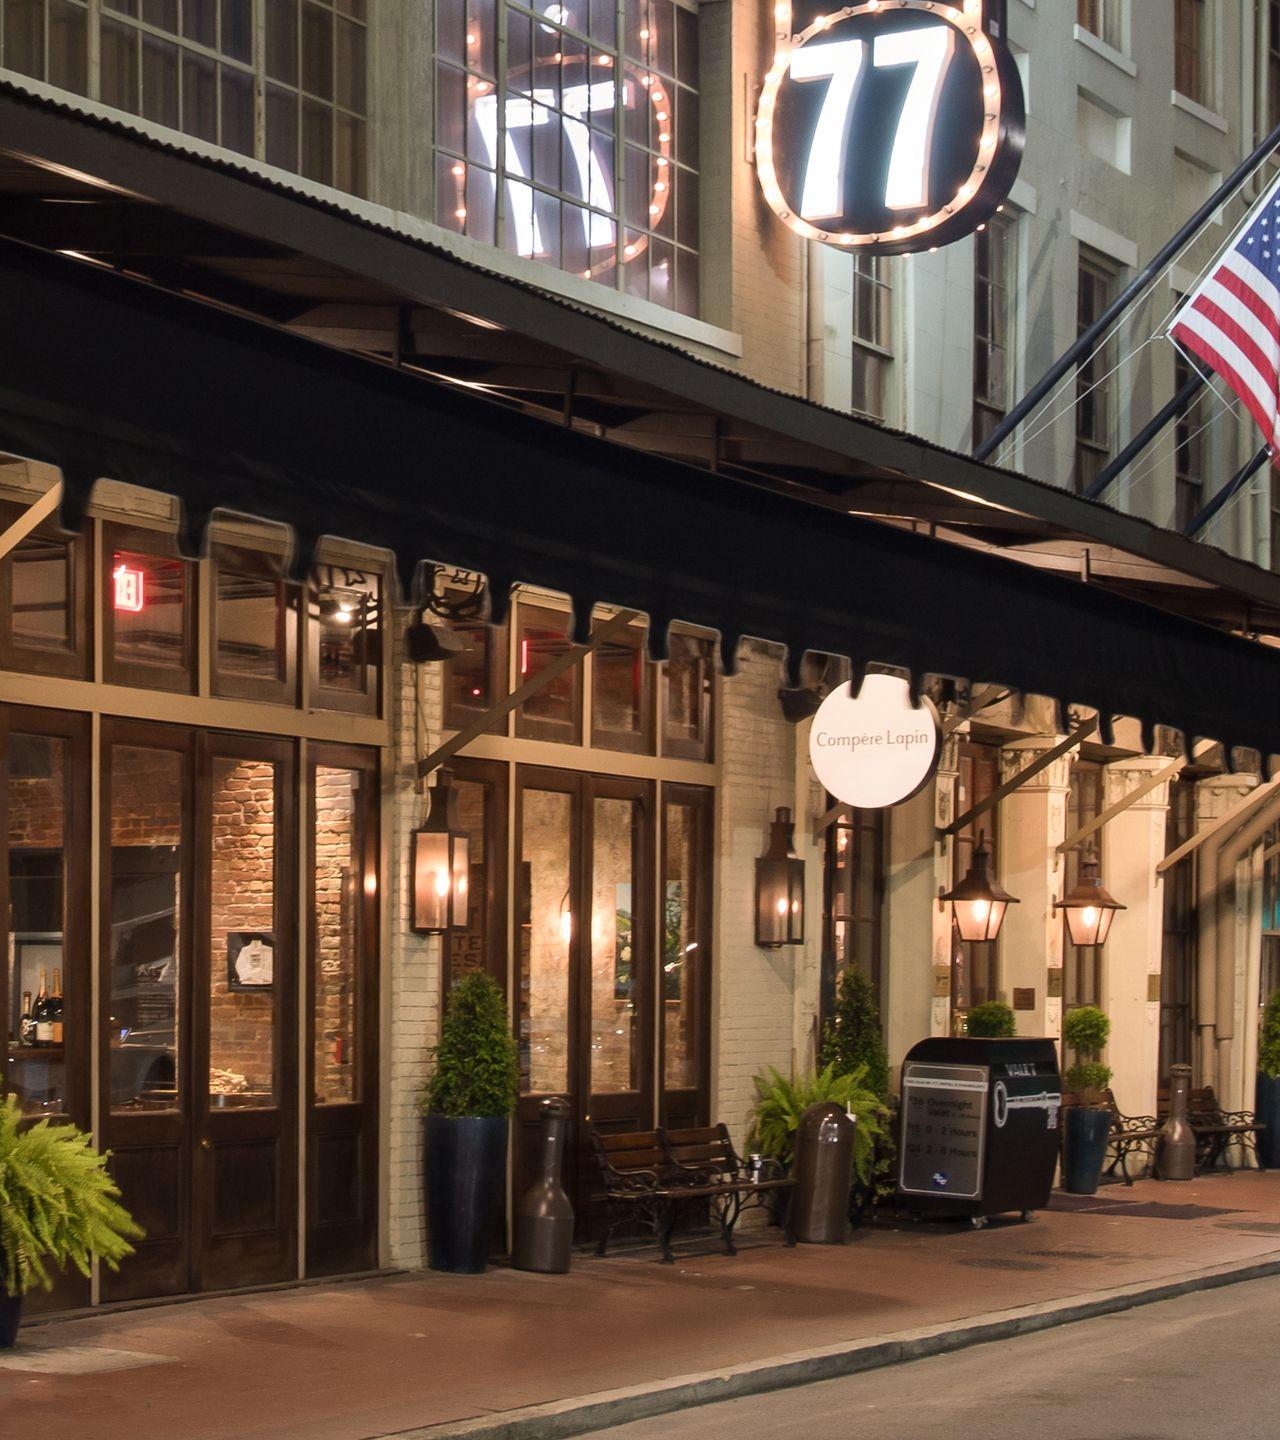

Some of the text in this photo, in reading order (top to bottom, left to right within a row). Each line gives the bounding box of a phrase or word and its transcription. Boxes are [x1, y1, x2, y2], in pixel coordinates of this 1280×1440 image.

[789, 25, 954, 219] 77
[816, 729, 929, 752] Compère Lapin
[1005, 1063, 1037, 1077] VALET
[927, 1097, 974, 1110] Overnight
[950, 1127, 977, 1137] Hours
[950, 1147, 977, 1158] Hours
